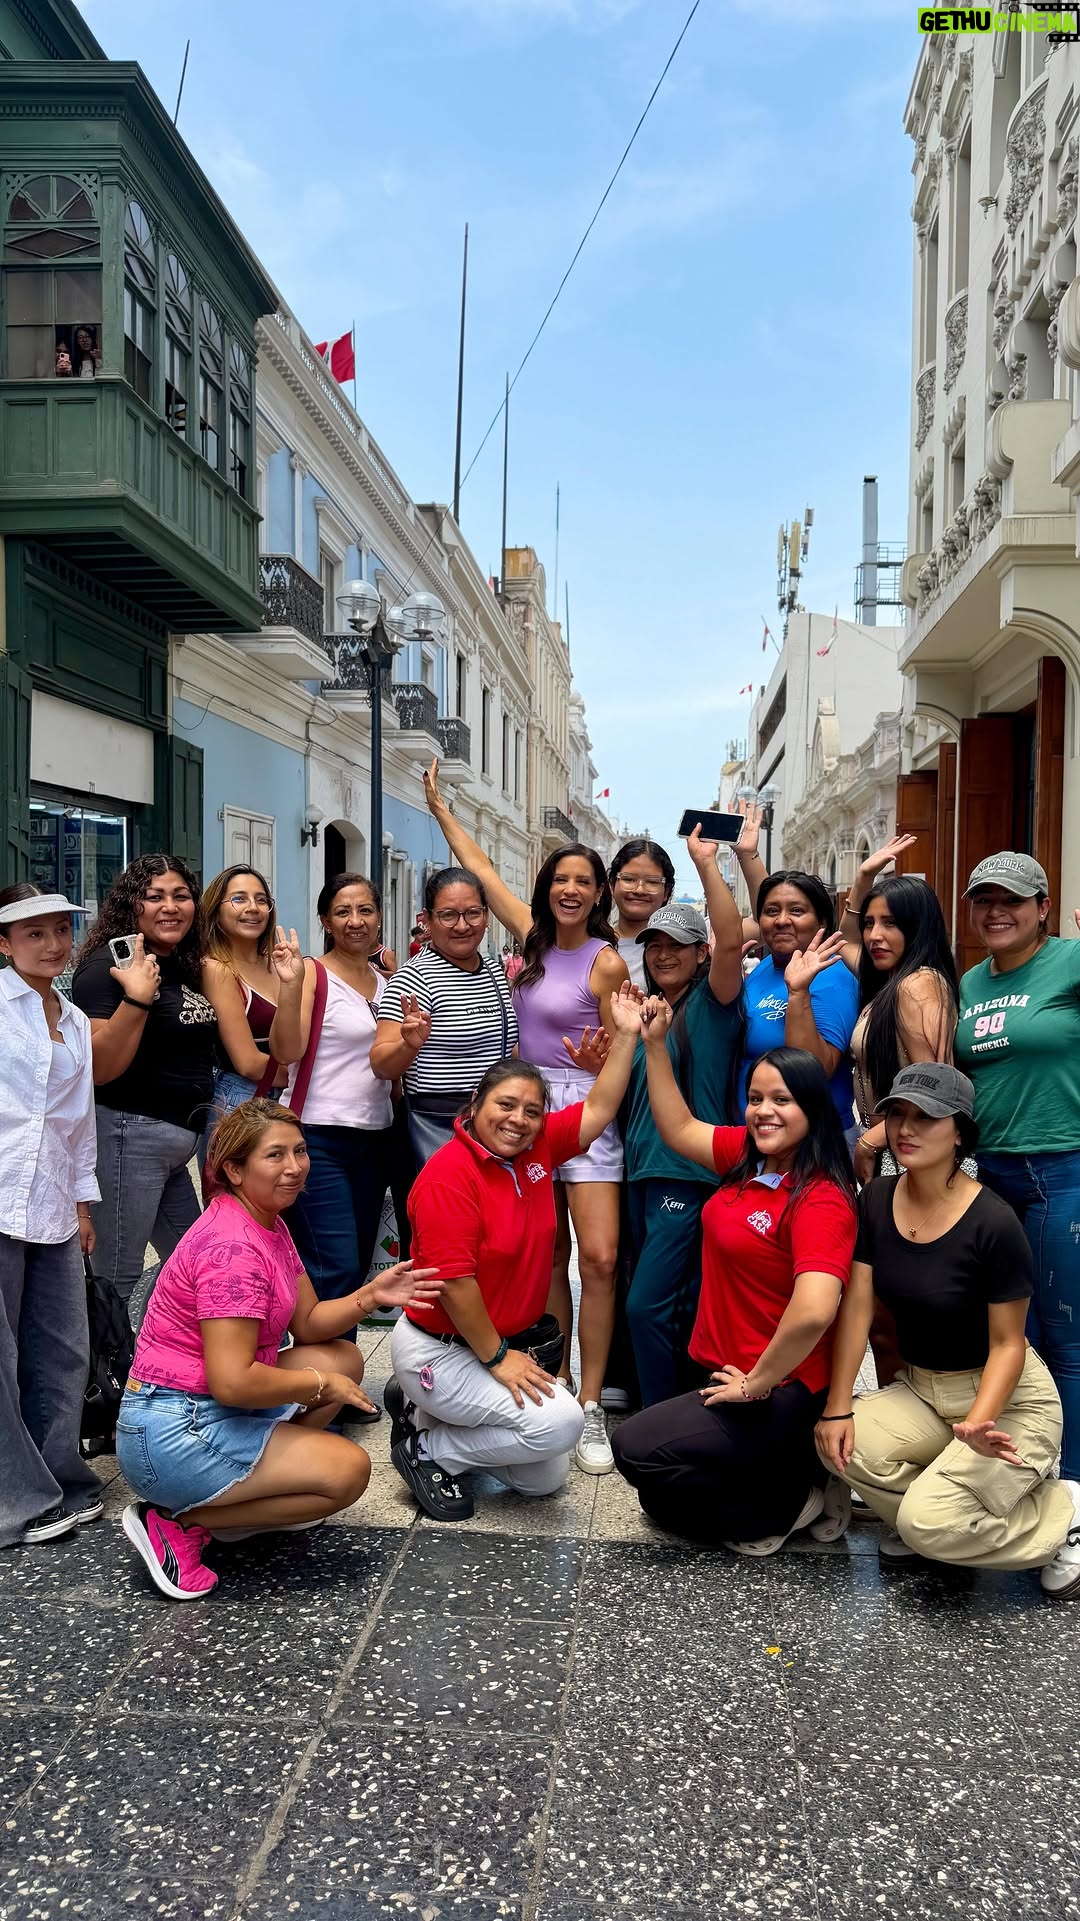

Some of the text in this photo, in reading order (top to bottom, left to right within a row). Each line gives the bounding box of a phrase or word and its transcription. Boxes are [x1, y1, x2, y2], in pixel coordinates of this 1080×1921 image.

[977, 857, 1025, 877] NEW YORK
[963, 994, 1031, 1020] ARIZONA
[974, 1011, 1006, 1038] 90
[971, 1036, 1010, 1053] PHOENIX
[527, 1163, 544, 1178] HIPER
[531, 1170, 548, 1184] CASA
[747, 1215, 766, 1235] CASA
[752, 1210, 772, 1230] HIPER
